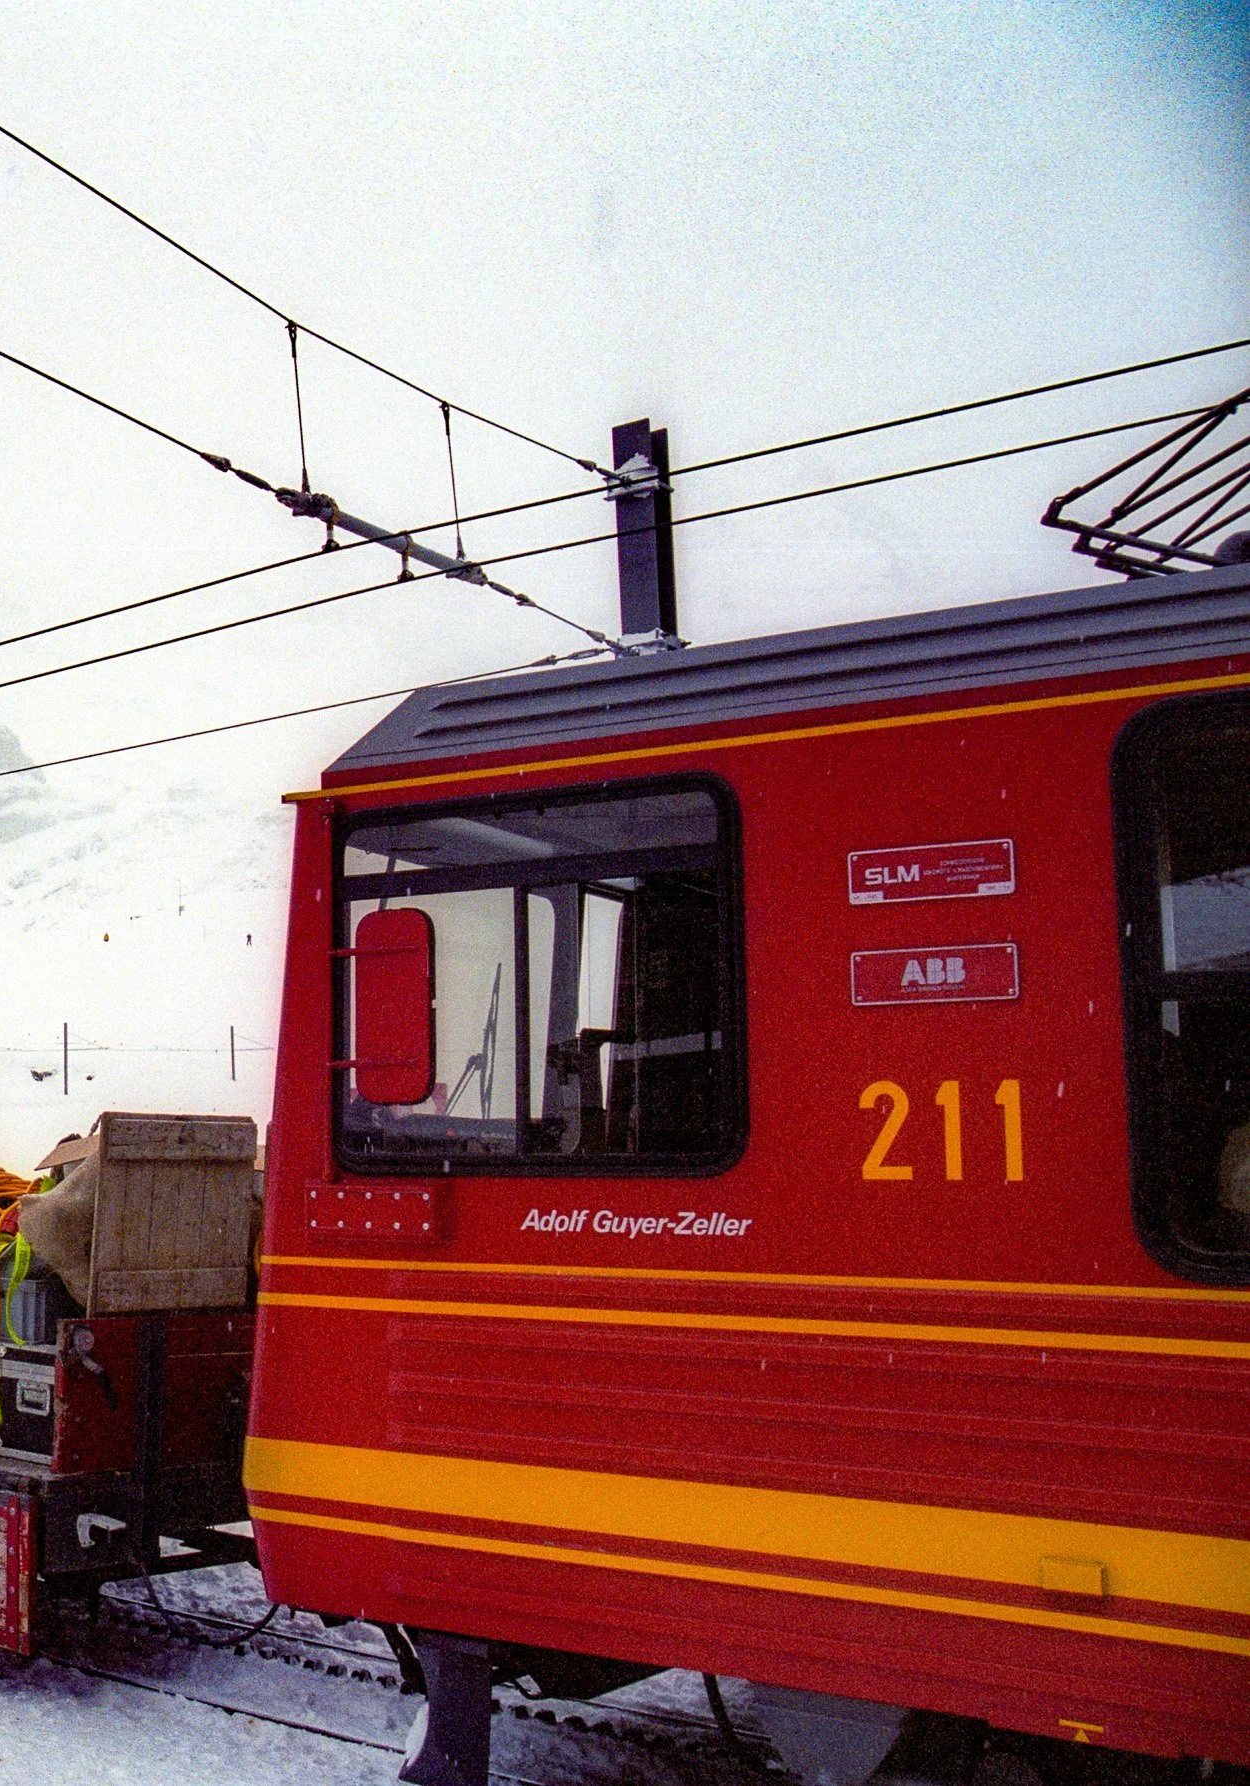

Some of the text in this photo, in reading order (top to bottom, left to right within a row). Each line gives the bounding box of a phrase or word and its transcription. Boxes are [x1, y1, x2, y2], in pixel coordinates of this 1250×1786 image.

[864, 864, 920, 886] SLM
[900, 957, 966, 986] ABB
[859, 1079, 1023, 1181] 211
[521, 1208, 752, 1239] Adolf Guyer-Zeller
